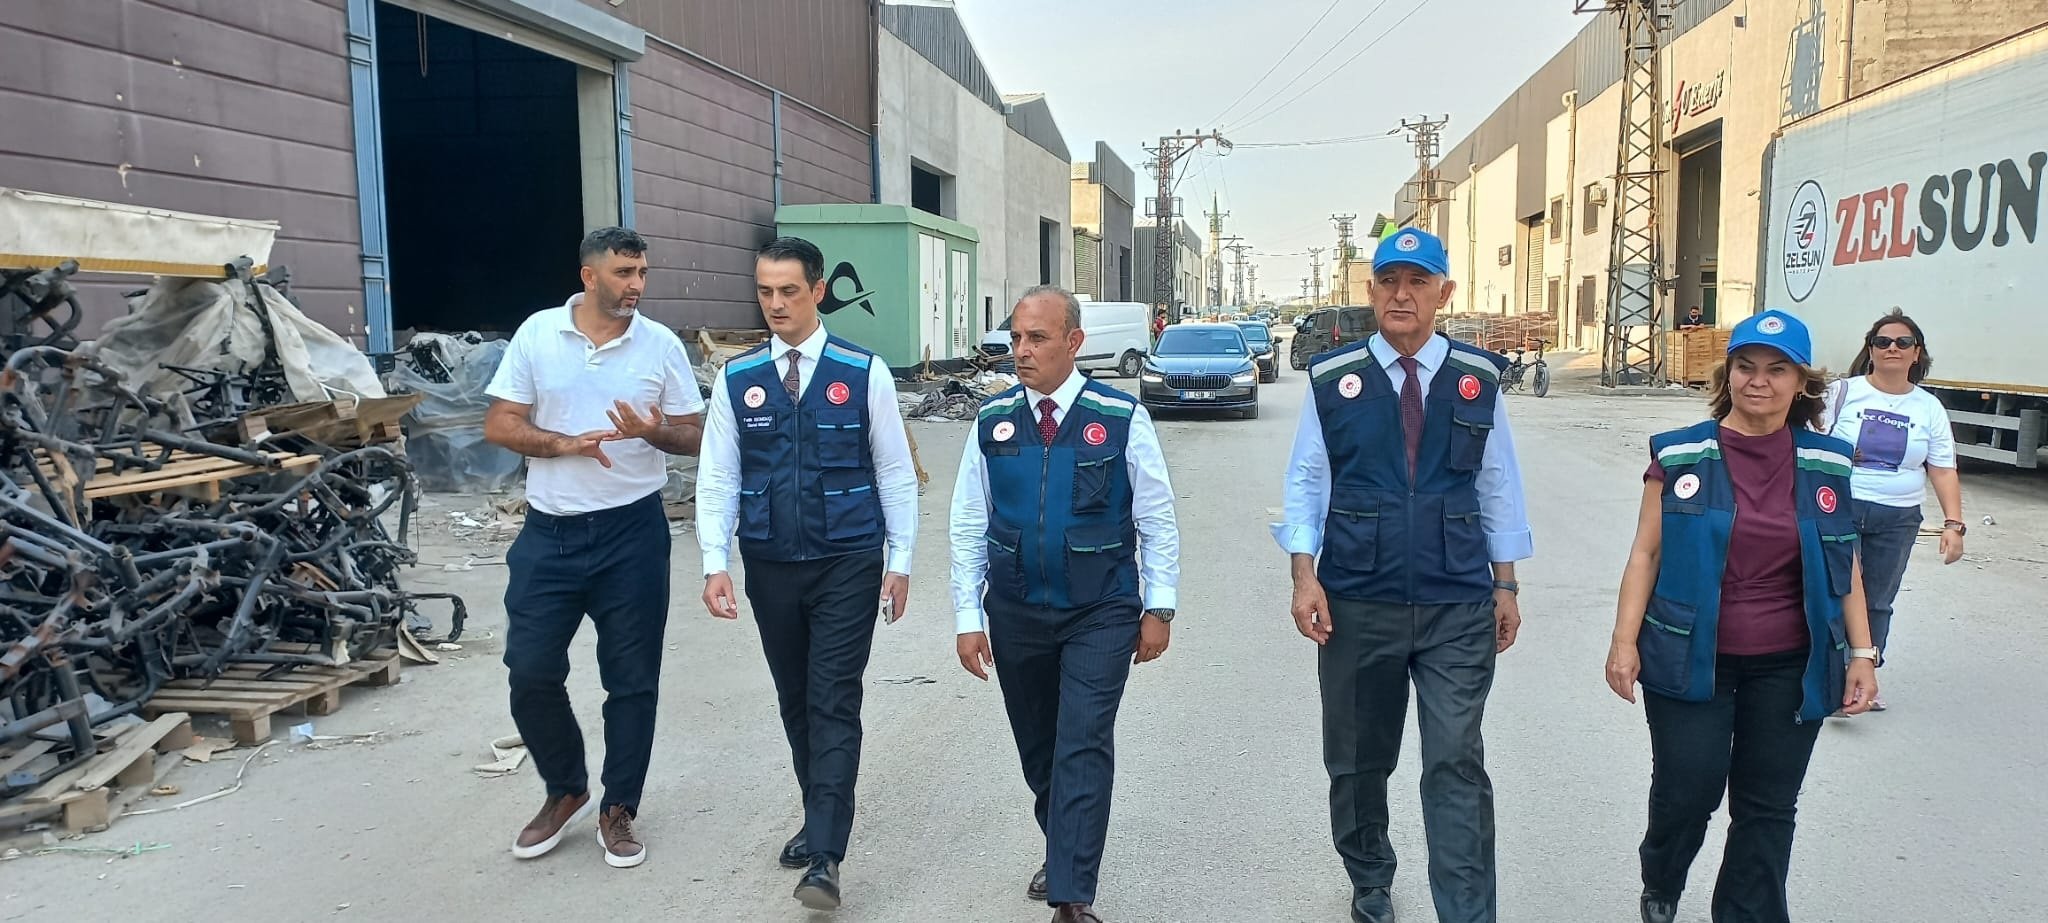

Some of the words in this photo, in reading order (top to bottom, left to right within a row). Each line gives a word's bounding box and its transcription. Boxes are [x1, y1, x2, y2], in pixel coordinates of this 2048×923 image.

[1833, 151, 2048, 266] ZELSUN
[1785, 249, 1821, 269] ZELSUN
[1856, 411, 1876, 421] Lee
[1877, 414, 1916, 429] Cooper
